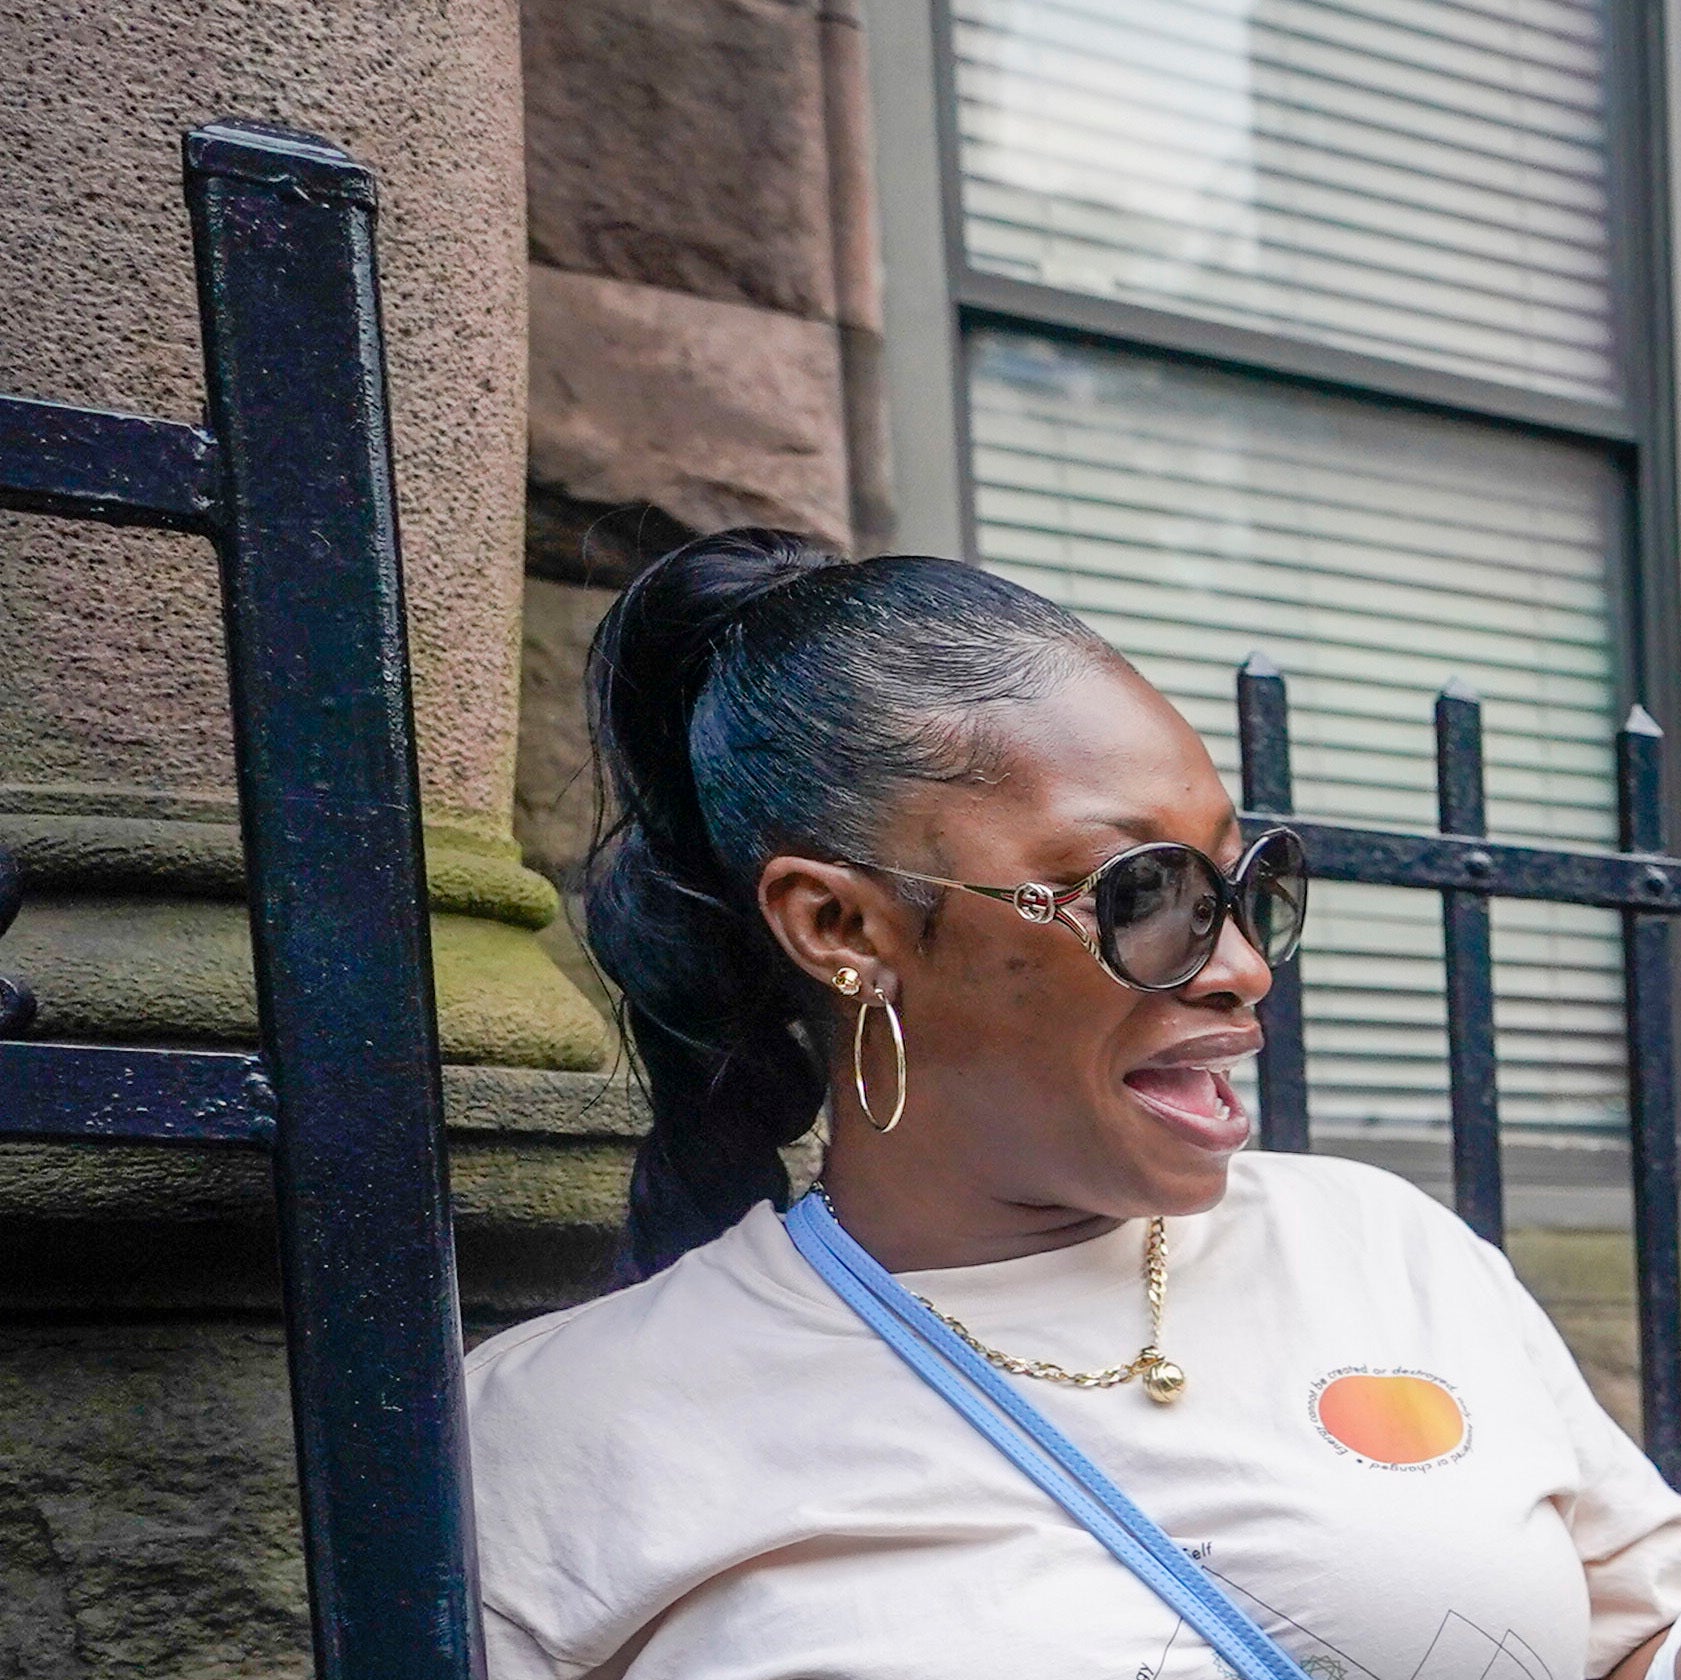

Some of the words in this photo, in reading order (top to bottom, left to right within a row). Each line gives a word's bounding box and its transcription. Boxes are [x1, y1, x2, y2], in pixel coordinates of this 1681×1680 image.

[1327, 1364, 1368, 1380] created
[1310, 1378, 1328, 1391] be
[1314, 1425, 1348, 1455] Energy
[1369, 1463, 1432, 1474] changed
